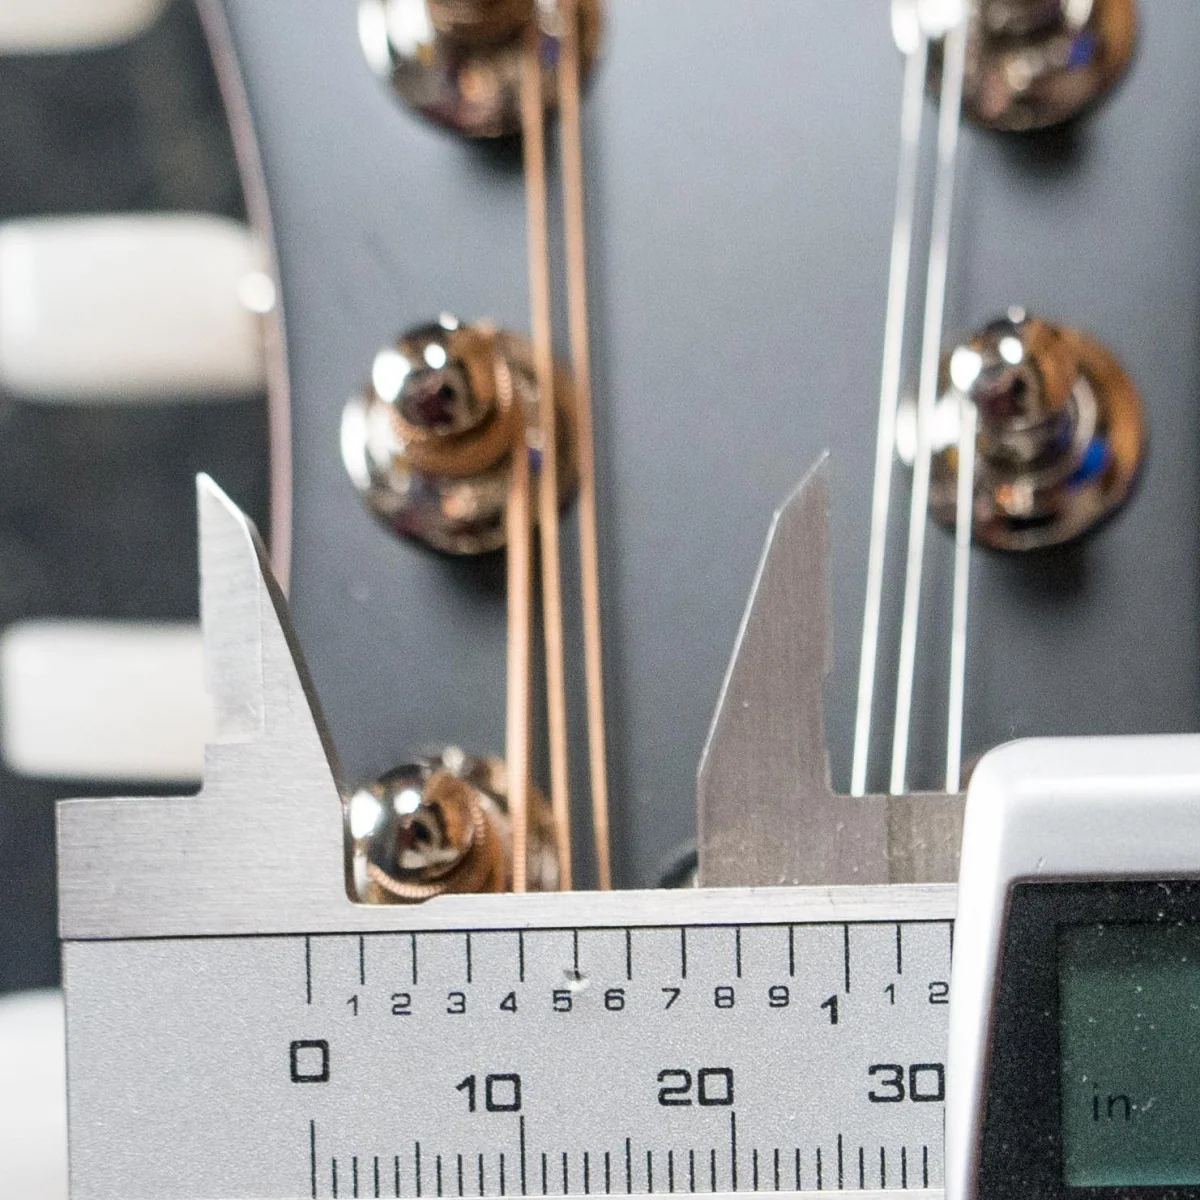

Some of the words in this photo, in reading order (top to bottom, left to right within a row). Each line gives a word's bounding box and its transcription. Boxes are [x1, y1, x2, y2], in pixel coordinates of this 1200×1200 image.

[347, 994, 359, 1016] 1
[391, 992, 412, 1015] 2
[446, 991, 466, 1014] 3
[499, 991, 518, 1012] 4
[552, 989, 573, 1012] 5
[604, 988, 626, 1011] 6
[661, 987, 681, 1009] 7
[714, 985, 735, 1009] 8
[768, 985, 790, 1008] 9
[820, 994, 838, 1024] 1
[883, 983, 896, 1004] 1
[928, 981, 949, 1004] 2
[455, 1073, 522, 1113] 10
[657, 1067, 734, 1106] 20
[868, 1063, 945, 1103] 30
[1091, 1083, 1132, 1122] in
